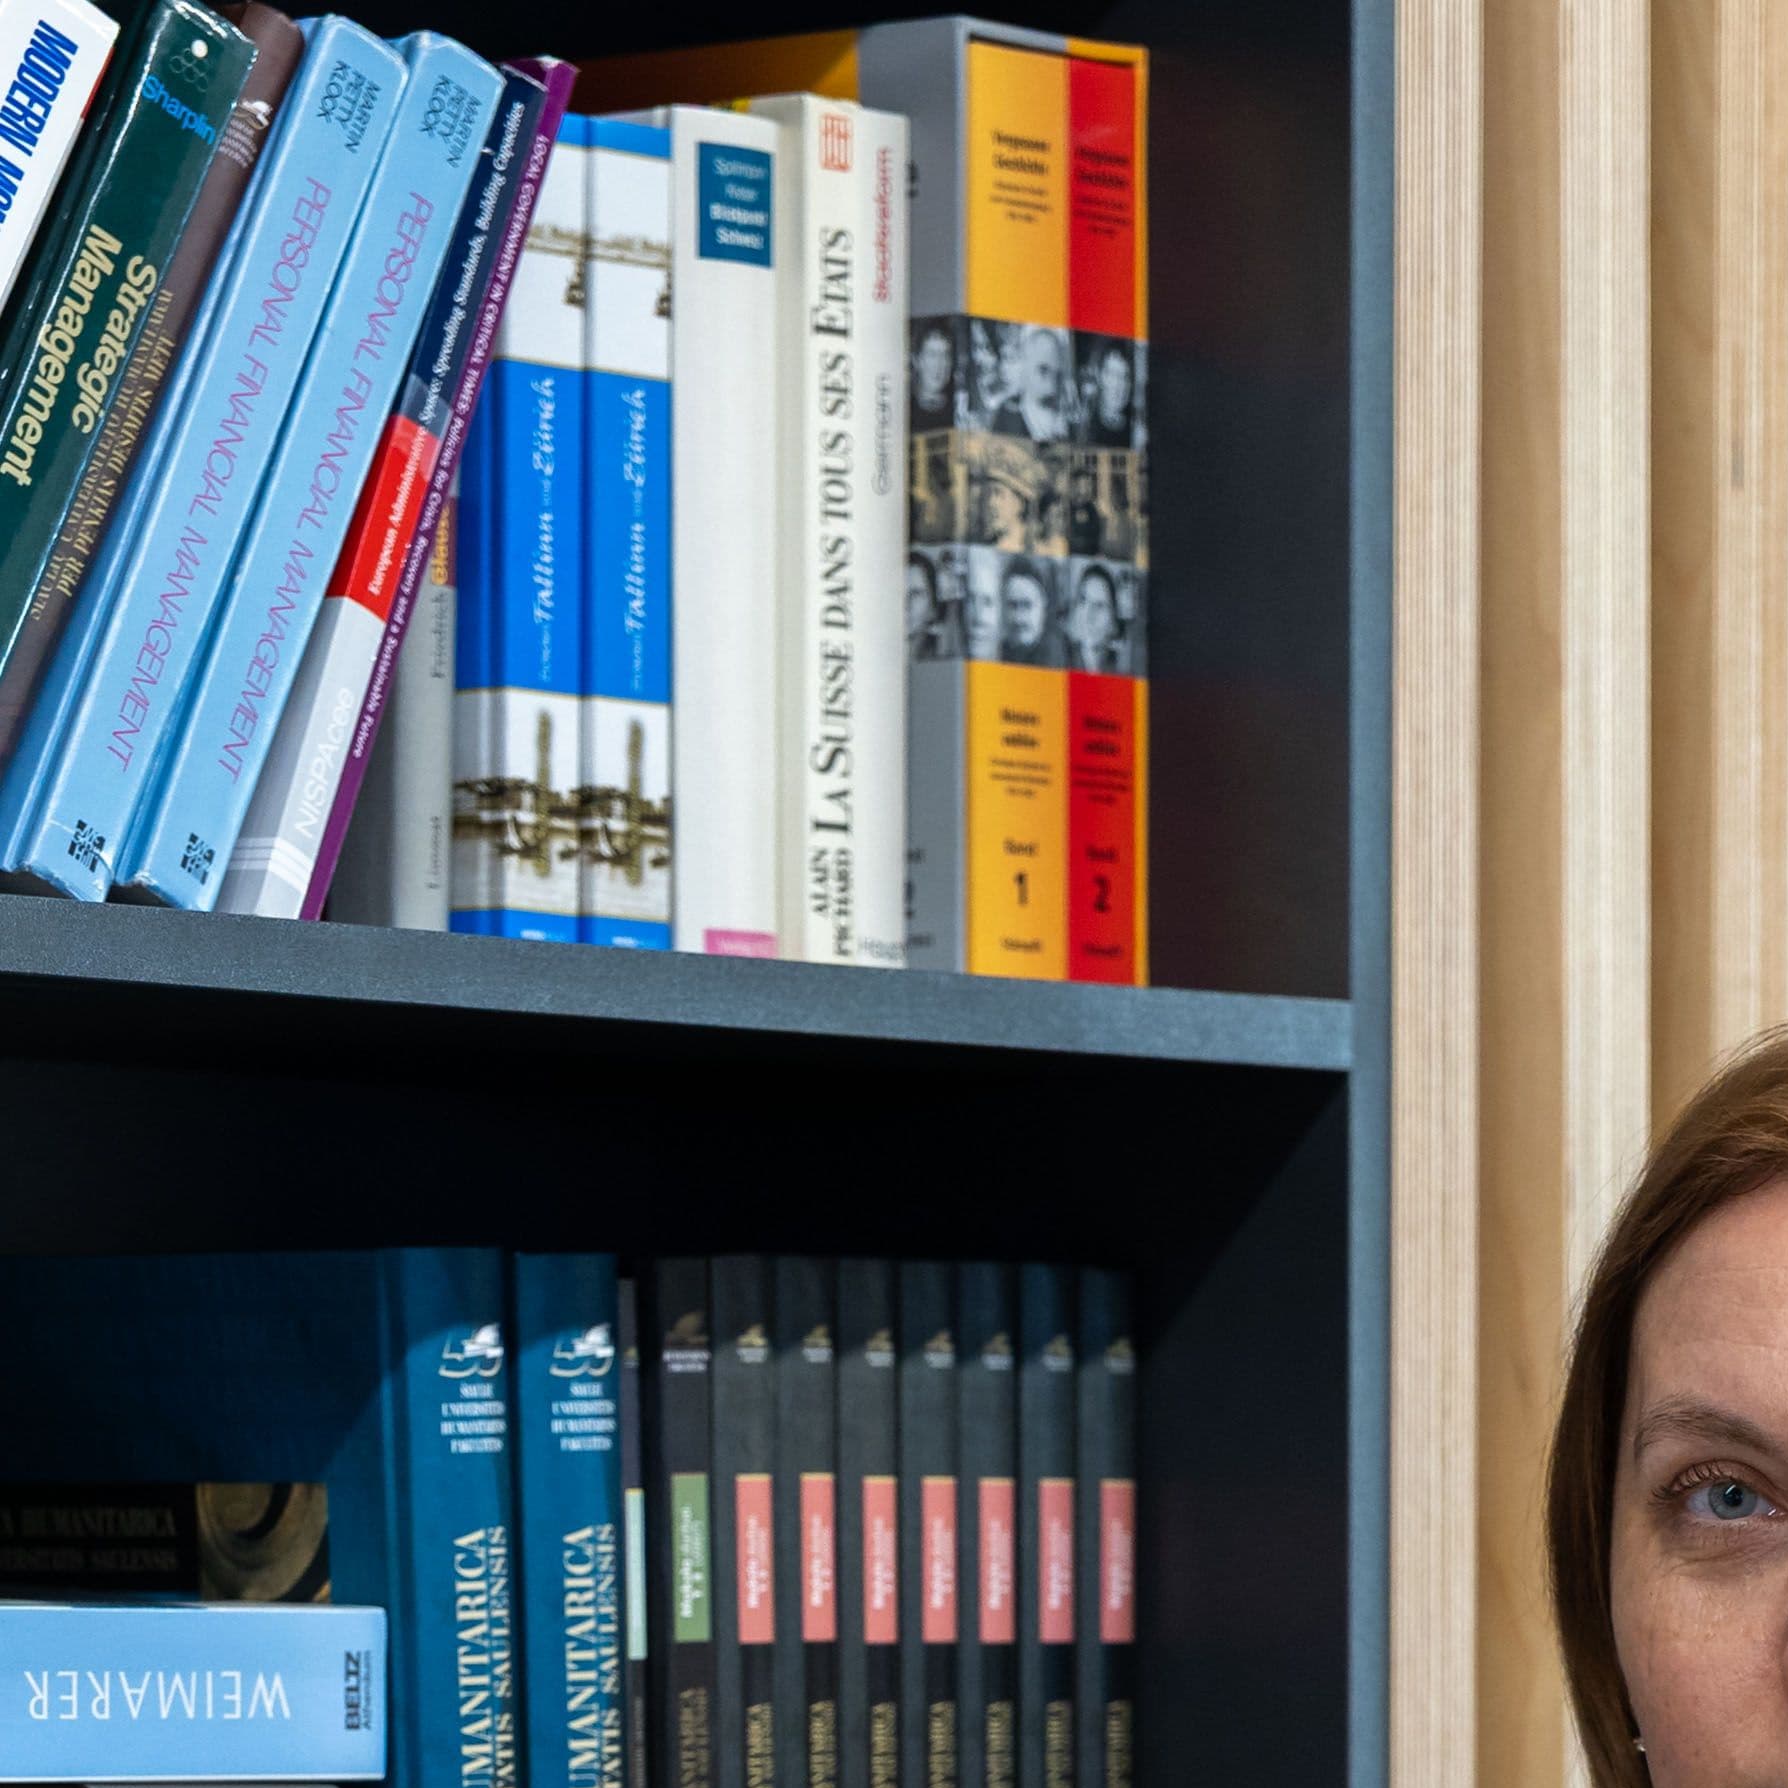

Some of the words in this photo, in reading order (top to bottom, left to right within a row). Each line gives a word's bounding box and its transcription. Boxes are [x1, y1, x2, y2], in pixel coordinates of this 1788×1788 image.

[0, 20, 79, 157] MODERN
[145, 75, 217, 146] Sharplin
[317, 59, 351, 124] KLOCK
[334, 69, 365, 131] PETTY
[344, 79, 382, 154] MARTIN
[419, 74, 453, 138] KLOCK
[436, 85, 468, 145] PETTY
[446, 94, 482, 169] MARTIN
[527, 135, 551, 181] LOCAL
[247, 176, 332, 347] PERSONAL
[494, 183, 537, 281] GOVERNMENT
[353, 191, 434, 361] PERSONAL
[490, 283, 505, 301] IN
[0, 223, 124, 487] Management
[72, 254, 158, 434] Strategic
[366, 527, 399, 595] European
[385, 425, 432, 525] Administrative
[430, 305, 468, 377] Spreading
[450, 230, 488, 305] Standards,
[472, 171, 505, 231] Building
[490, 100, 528, 171] Capacities
[469, 304, 499, 365] CRITICAL
[820, 351, 853, 420] SES
[188, 352, 269, 518] FINANCIAL
[300, 366, 373, 530] FINANCIAL
[439, 417, 466, 468] Policies
[819, 430, 853, 526] TOUS
[55, 556, 85, 596] PER
[392, 596, 410, 623] and
[820, 535, 853, 631] DANS
[107, 525, 209, 773] MANAGEMENT
[218, 541, 315, 784] MANAGEMENT
[364, 636, 399, 712] Sustainable
[811, 642, 853, 778] SUISSE
[296, 687, 354, 839] NISPAcee
[811, 787, 853, 835] LA
[487, 1524, 515, 1699] SAULENSIS
[595, 1521, 621, 1695] SAULENSIS
[22, 1669, 292, 1721] WEIMARER
[344, 1650, 362, 1733] BELTZ
